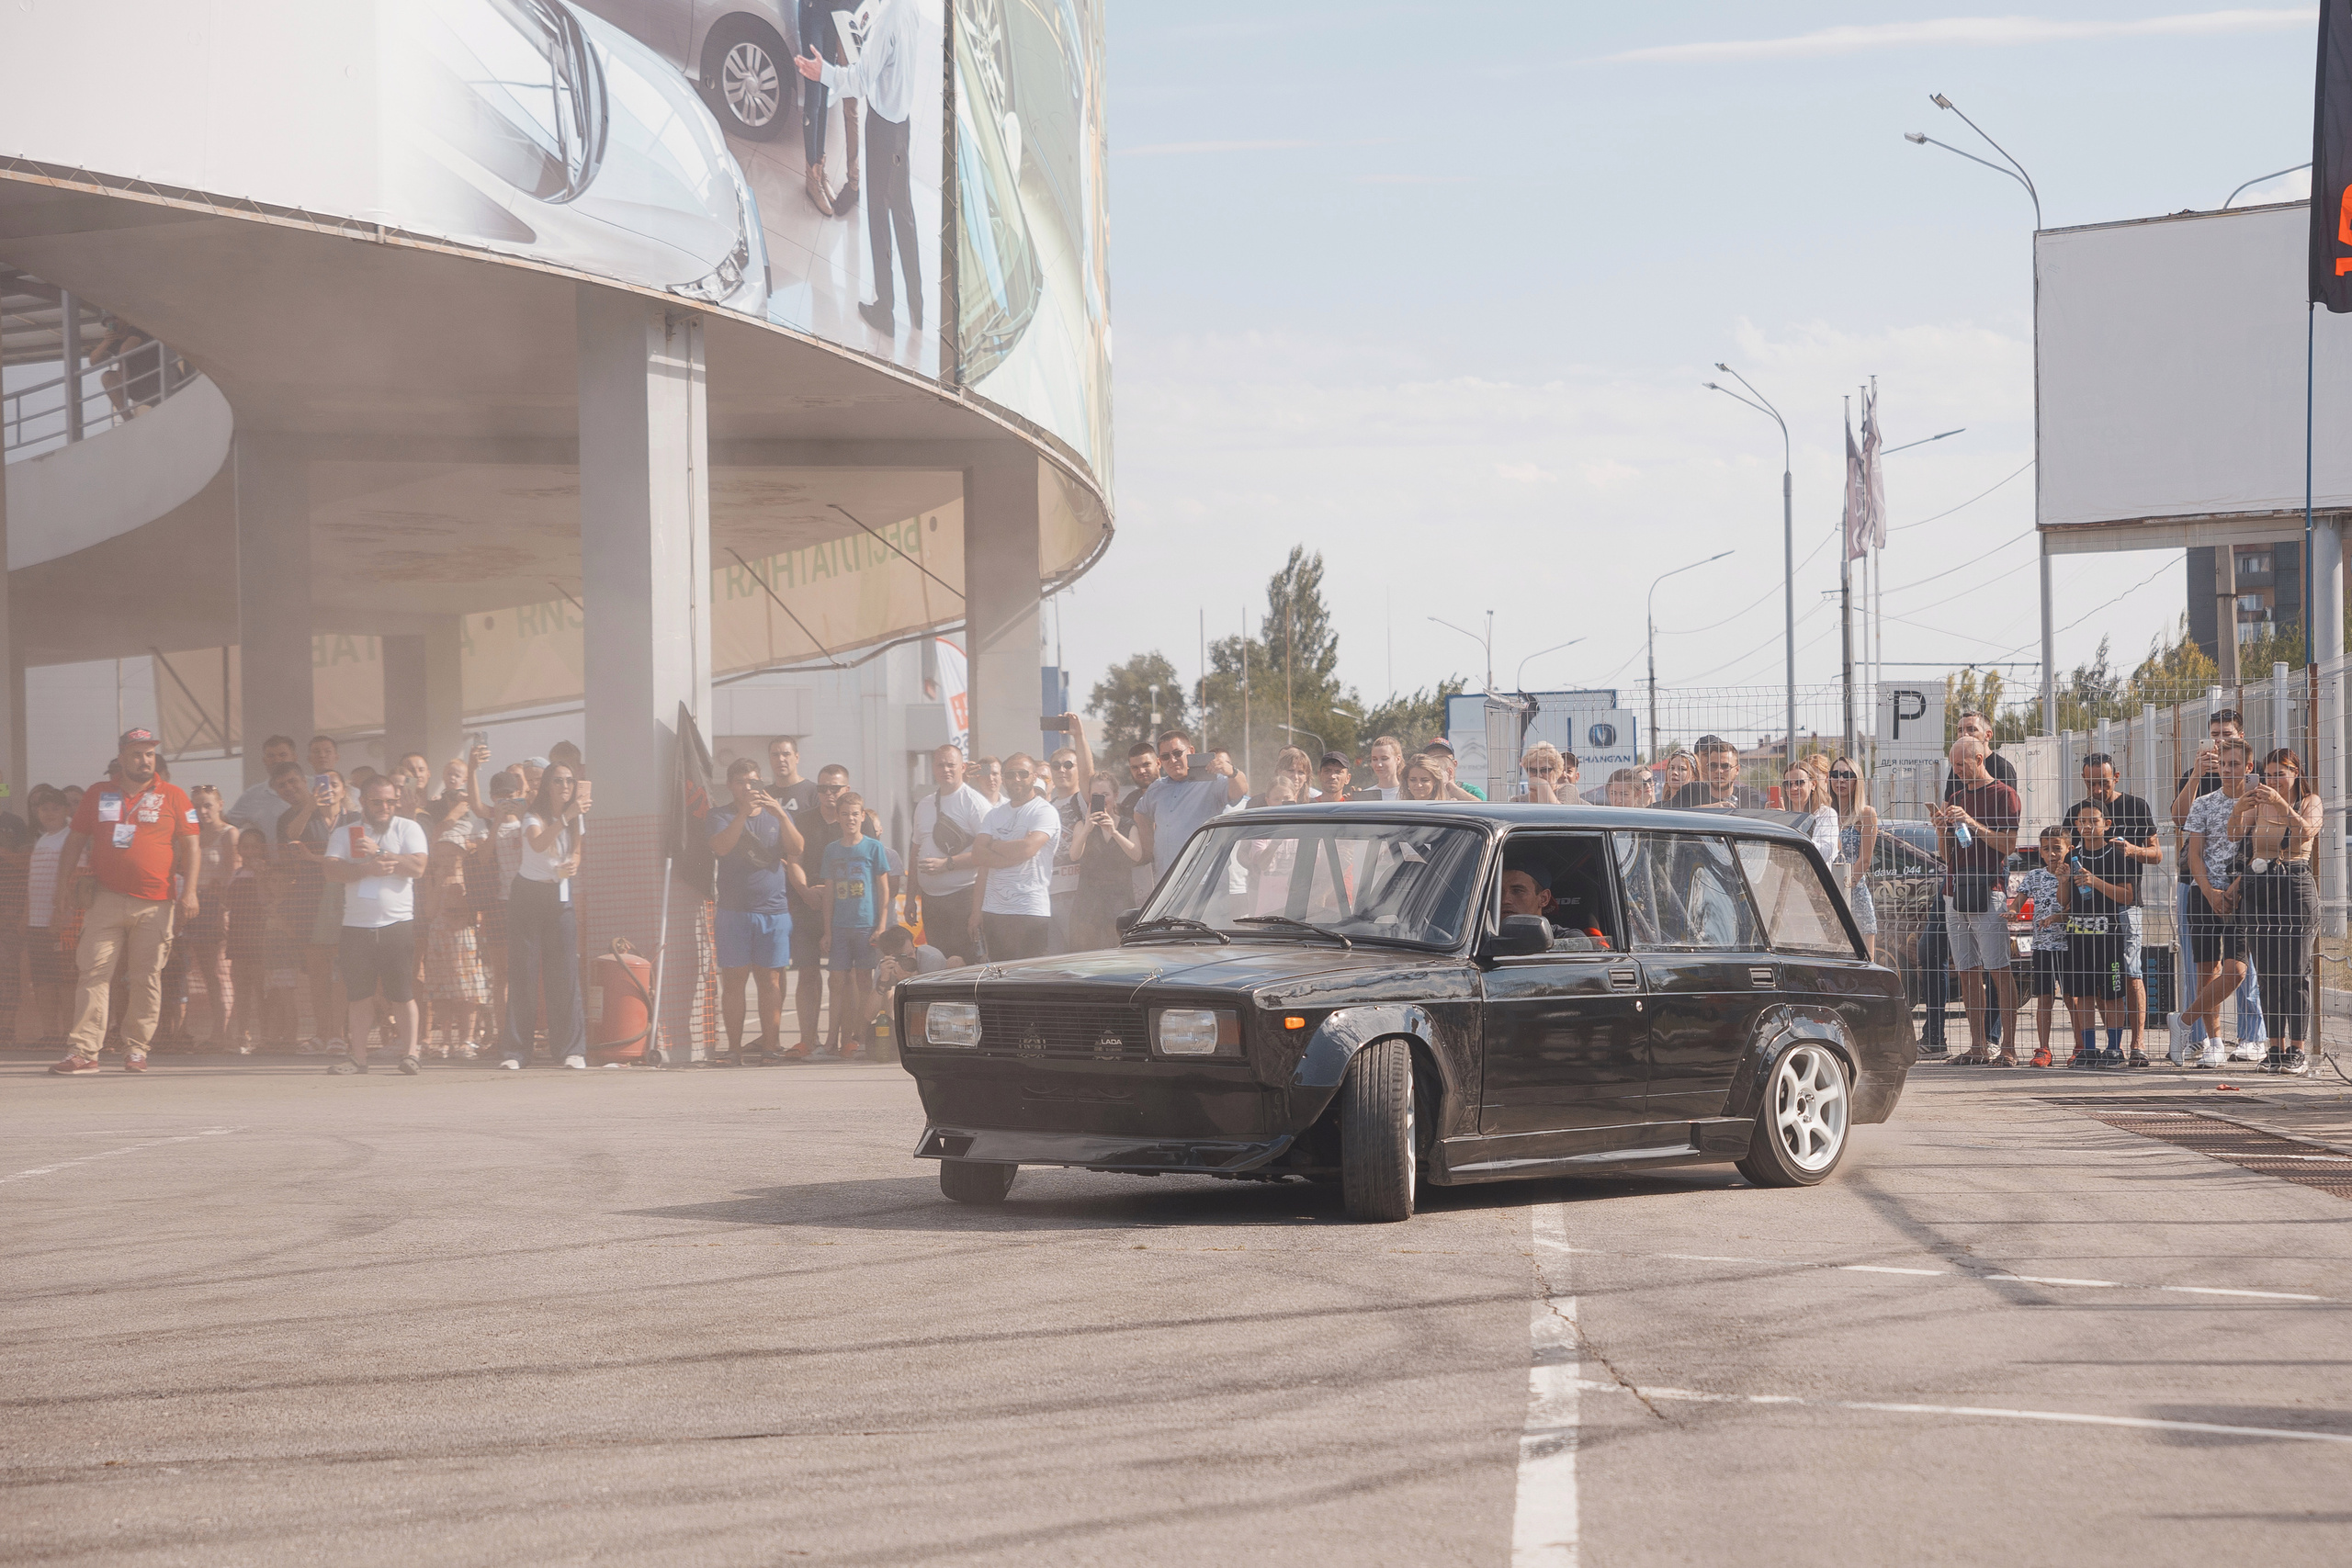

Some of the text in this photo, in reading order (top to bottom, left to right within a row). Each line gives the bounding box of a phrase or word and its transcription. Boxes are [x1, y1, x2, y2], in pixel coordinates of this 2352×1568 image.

[1893, 690, 1927, 740] P
[1061, 865, 1080, 876] COR
[1874, 865, 1921, 878] dava_044
[2066, 915, 2109, 934] PEED
